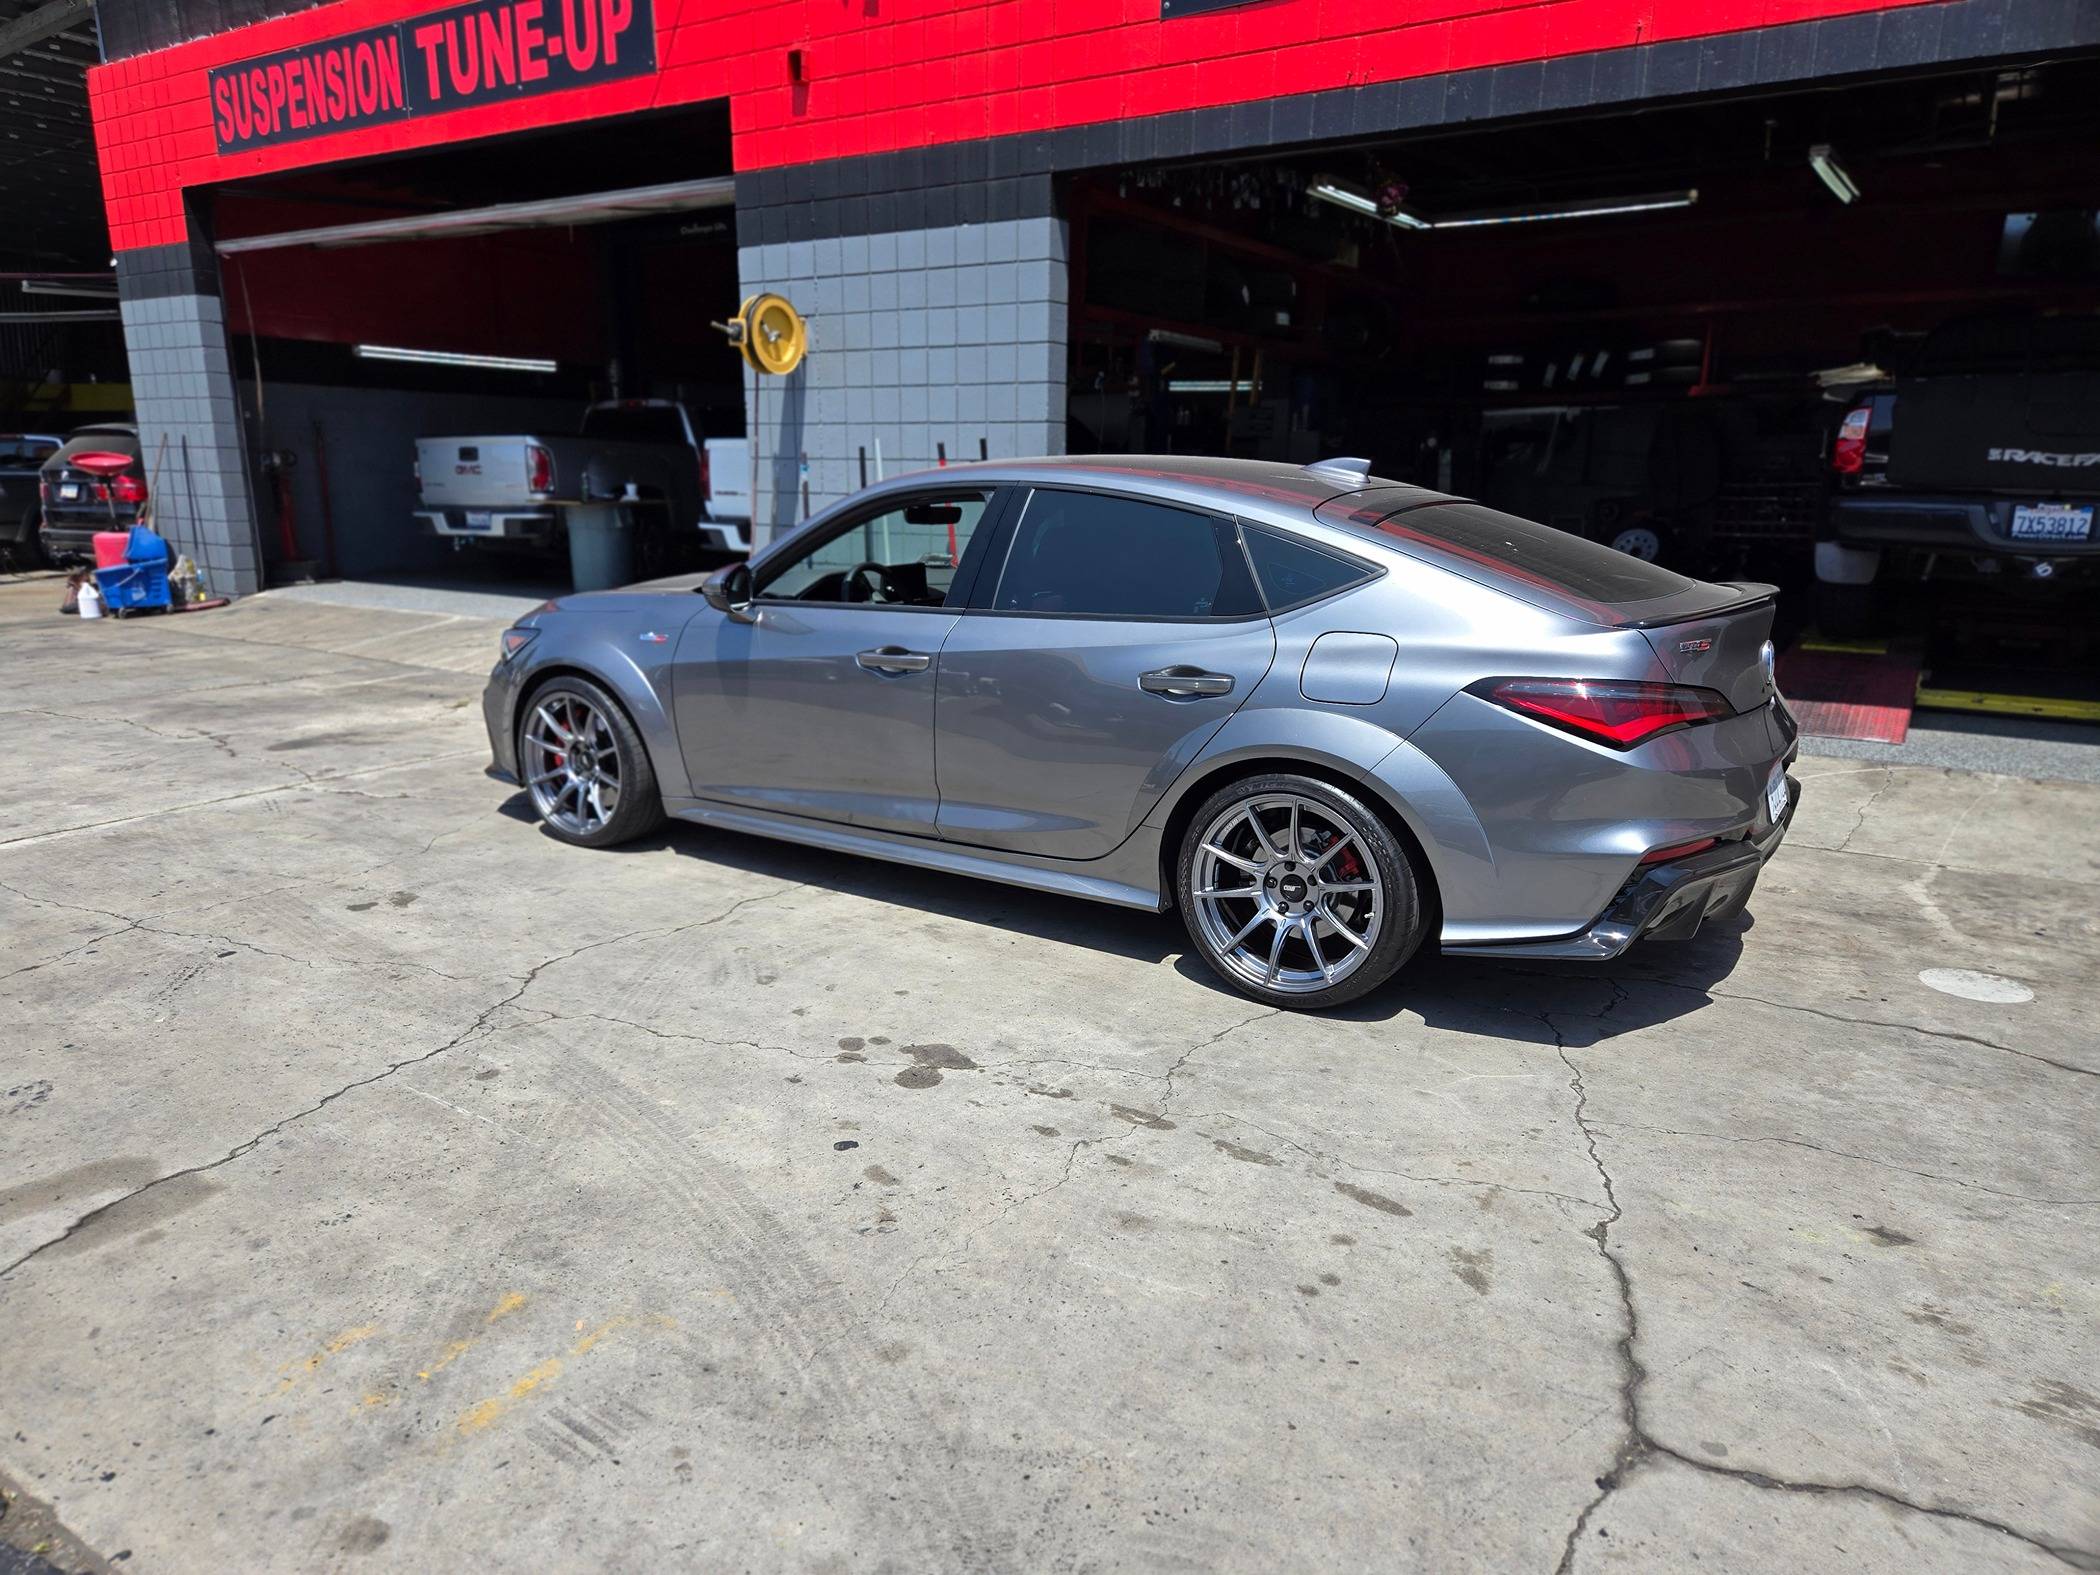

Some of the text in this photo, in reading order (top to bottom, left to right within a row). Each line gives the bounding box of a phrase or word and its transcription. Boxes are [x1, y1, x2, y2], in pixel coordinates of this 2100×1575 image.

[215, 0, 632, 143] SUSPENSION TUNE-UP
[455, 464, 483, 475] GMC
[2016, 515, 2088, 534] 7X53812
